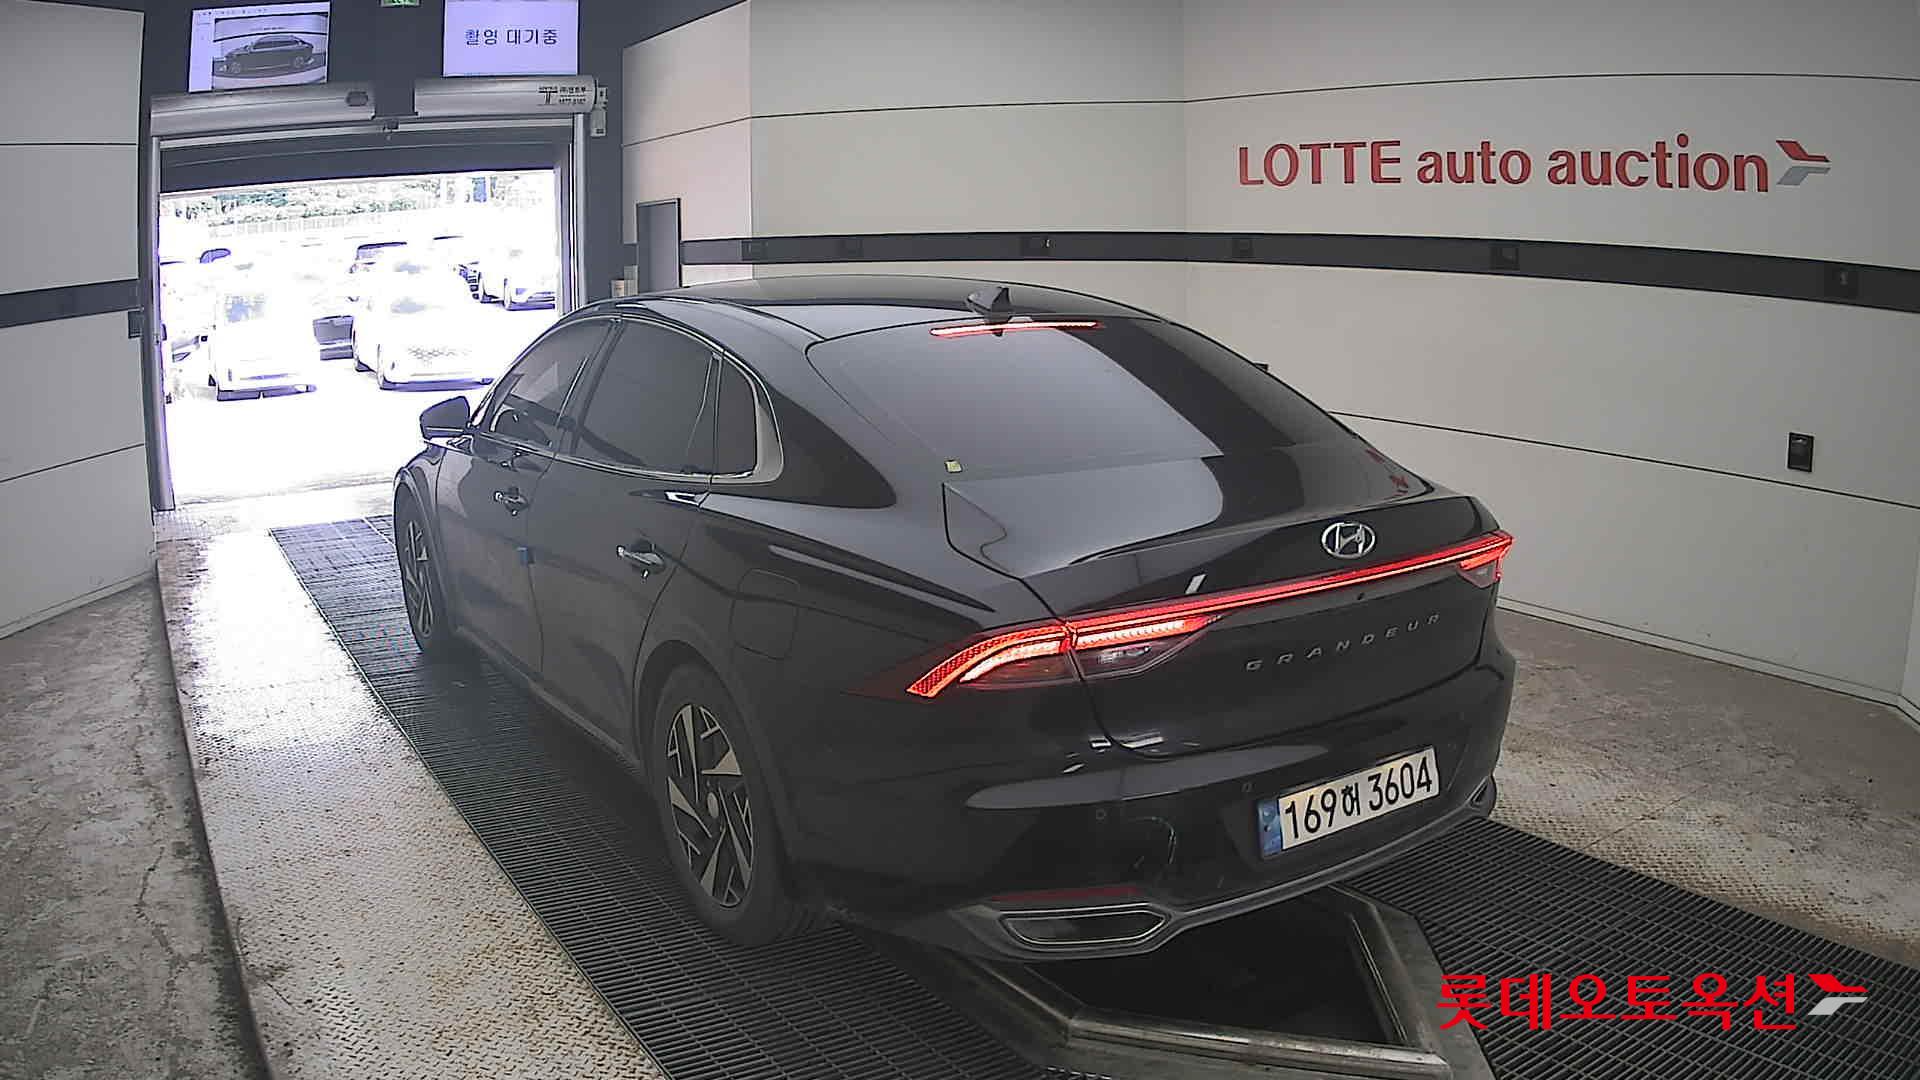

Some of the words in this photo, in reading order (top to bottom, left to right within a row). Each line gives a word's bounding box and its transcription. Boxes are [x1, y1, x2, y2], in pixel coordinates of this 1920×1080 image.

[506, 28, 558, 46] 대기중
[1239, 140, 1401, 187] LOTTE
[1415, 140, 1532, 185] auto
[1547, 132, 1769, 193] auction
[1245, 613, 1441, 671] GRANDEUR
[1284, 781, 1360, 840] 169허
[1367, 755, 1433, 812] 3604
